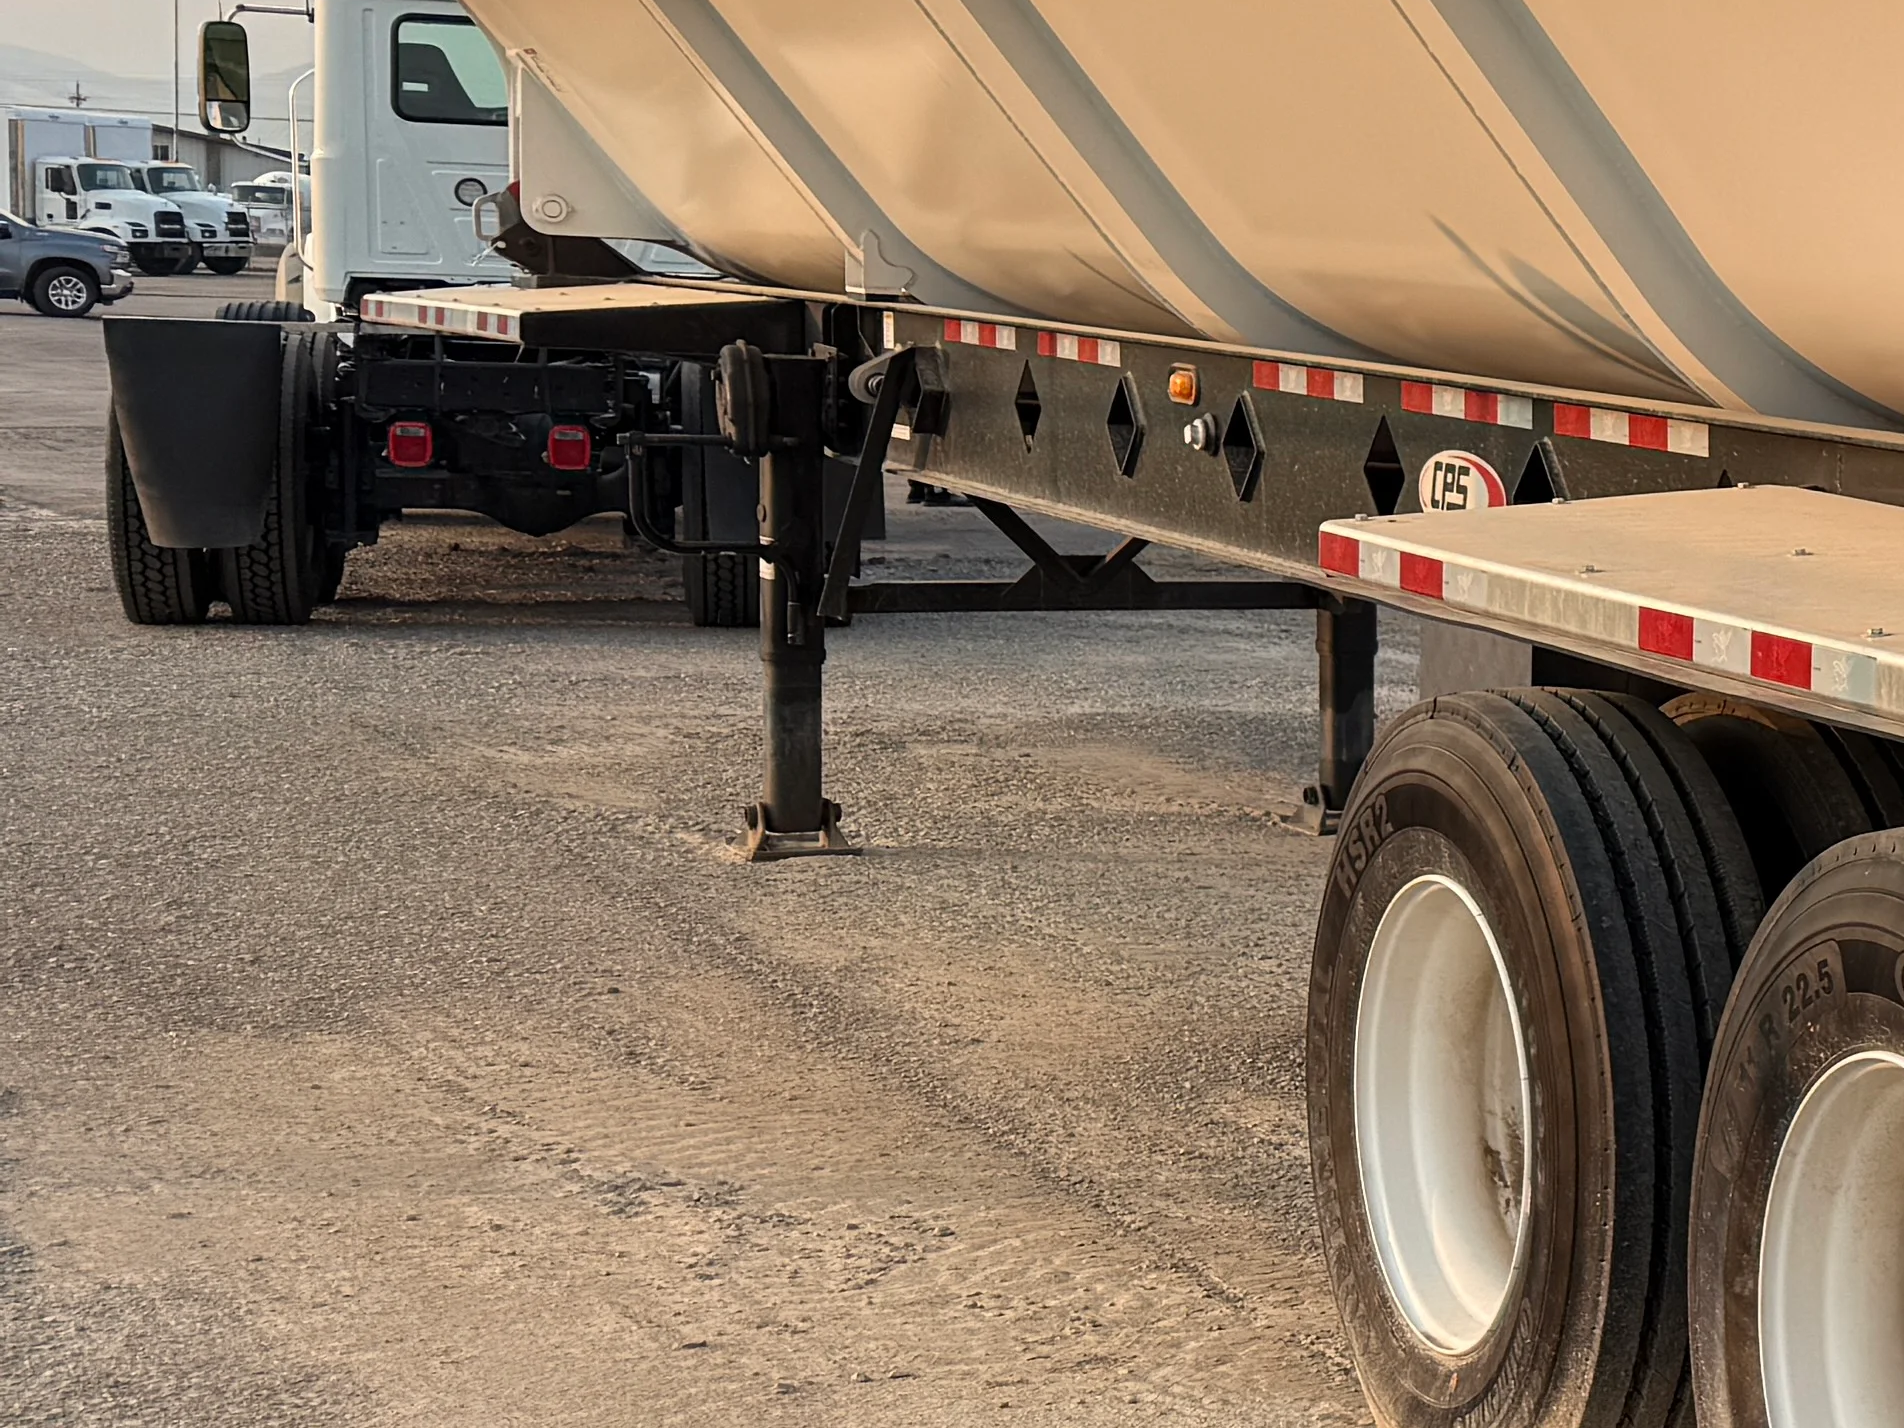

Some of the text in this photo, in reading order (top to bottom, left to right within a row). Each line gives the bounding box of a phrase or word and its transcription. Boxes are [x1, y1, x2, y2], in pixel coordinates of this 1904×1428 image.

[1431, 461, 1470, 510] CPS
[1335, 793, 1394, 900] HSR2
[1781, 959, 1836, 1024] 22.5
